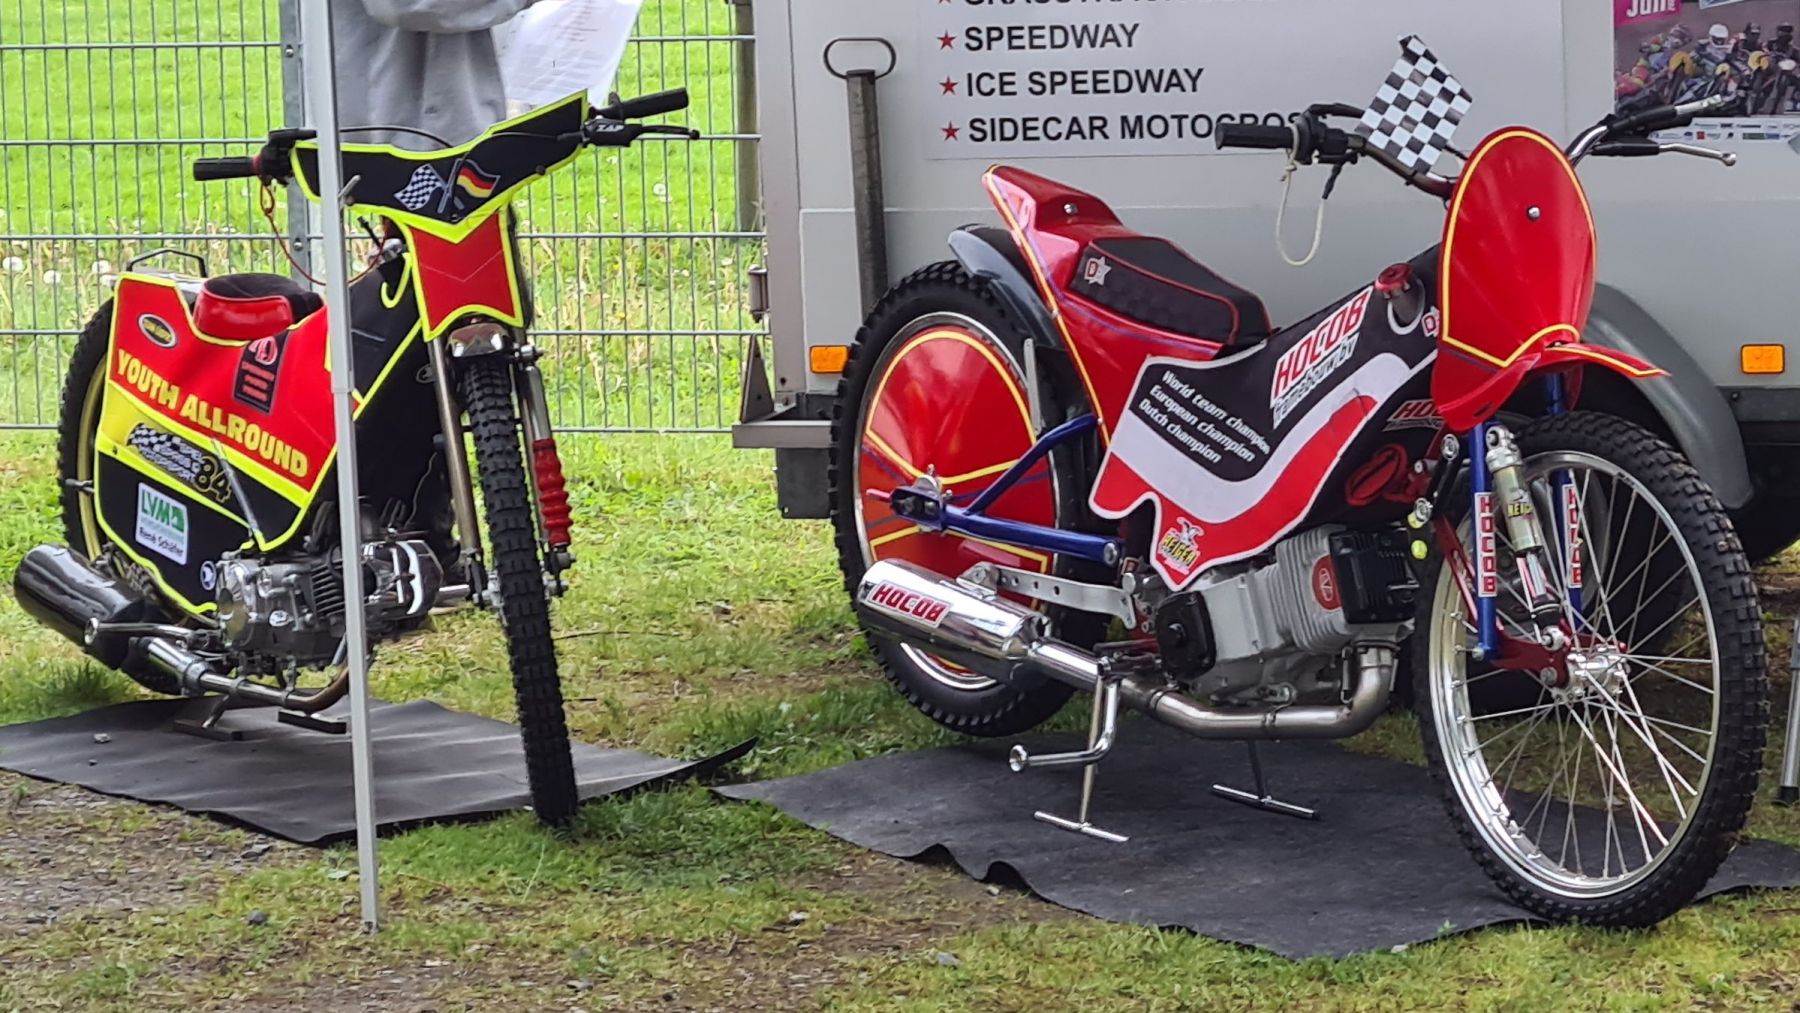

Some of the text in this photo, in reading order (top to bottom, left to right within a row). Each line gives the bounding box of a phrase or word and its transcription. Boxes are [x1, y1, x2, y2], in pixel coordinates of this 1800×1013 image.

[964, 23, 1140, 51] SPEEDWAY
[966, 68, 1204, 97] ICE SPEEDWAY
[968, 115, 1110, 143] SIDECAR
[1273, 289, 1370, 399] HOCOB
[117, 348, 180, 410] YOUTH
[180, 394, 309, 478] ALLROUND
[1149, 384, 1256, 463] European champion
[1162, 370, 1196, 399] World
[1192, 394, 1228, 420] team
[1138, 398, 1222, 464] Dutch champion
[1480, 496, 1497, 593] HOCOB
[871, 583, 947, 622] HOCOB
